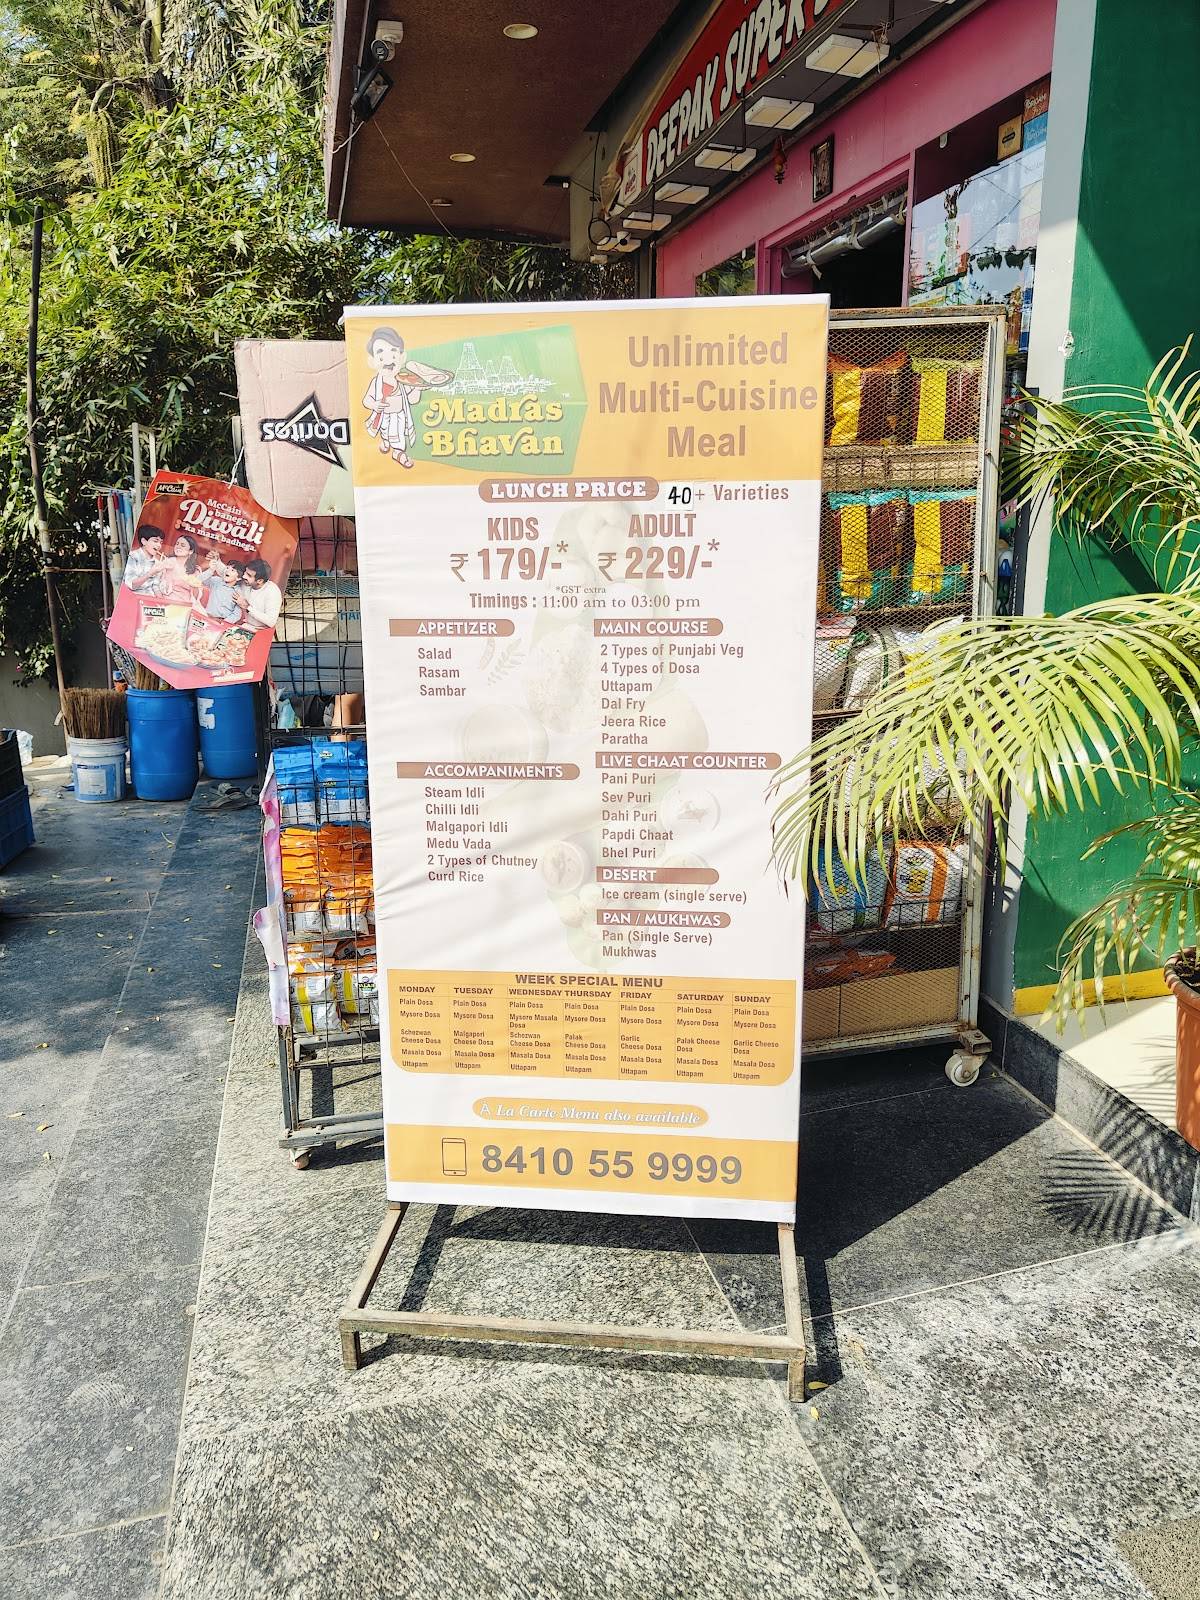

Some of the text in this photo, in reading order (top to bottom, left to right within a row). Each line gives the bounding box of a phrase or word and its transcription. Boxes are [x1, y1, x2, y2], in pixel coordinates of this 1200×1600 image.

[646, 55, 720, 185] DEEPAK
[628, 332, 788, 367] Unlimited
[599, 377, 818, 414] Multi-Cuisine
[422, 392, 563, 427] Madras
[263, 421, 348, 443] Doritos
[423, 428, 564, 456] Bhavan
[668, 425, 746, 458] Meal
[491, 482, 646, 498] LUNCH PRICE
[713, 484, 789, 501] Varieties
[207, 499, 241, 515] McCain
[180, 500, 265, 544] Diwali
[628, 514, 697, 538] ADULT
[487, 517, 539, 541] KIDS
[583, 586, 606, 594] extra
[469, 592, 701, 613] Timings 11:00 am to 03:00 pm
[417, 622, 497, 635] APPETIZER
[600, 621, 708, 634] MAIN COURSE
[418, 648, 452, 659] Salad
[600, 643, 744, 658] 2 Types of Punjabi Veg
[419, 667, 460, 678] Rasam
[600, 662, 700, 676] 4 Types of Dosa
[420, 684, 466, 697] Sambar
[601, 680, 652, 695] Uttapam
[601, 698, 646, 712] Dal Fry
[601, 716, 666, 727] Jeera Rice
[602, 733, 648, 745] Paratha
[601, 755, 767, 768] LIVE CHAAT COUNTER
[424, 765, 563, 778] ACCOMPANIMENTS
[601, 773, 655, 785] Pani Puri
[425, 787, 485, 798] Steam Idli
[602, 792, 651, 803] Sev Puri
[425, 803, 479, 815] Chilli Idli
[602, 810, 657, 822] Dahi Puri
[426, 820, 508, 835] Malgapori Idli
[602, 829, 673, 842] Papdi Chaat
[427, 838, 491, 849] Medu Vada
[602, 847, 656, 859] Bhel Puri
[427, 855, 537, 869] 2 Types of Chutney
[428, 871, 484, 882] Curd Rice
[603, 869, 657, 881] DESERT
[602, 888, 747, 905] Ice cream (single serve)
[603, 913, 631, 924] PAN
[644, 914, 720, 926] MUKHWAS
[602, 930, 712, 946] Pan (Single Serve)
[602, 946, 657, 958] Mukhwas
[515, 974, 663, 987] WEEK SPECIAL MENU
[565, 990, 612, 998] THURSDAY
[677, 993, 724, 1001] SATURDAY
[734, 995, 771, 1003] SUNDAY
[677, 1006, 693, 1014] Plain
[734, 1008, 750, 1016] Plain
[621, 1017, 644, 1025] Mysore
[696, 1038, 720, 1046] Cheese
[734, 1039, 779, 1048] Garlic Cheese
[496, 1104, 514, 1116] La
[519, 1105, 555, 1118] Carte
[561, 1106, 599, 1120] Menu
[604, 1108, 630, 1122] also
[636, 1110, 700, 1125] available
[482, 1144, 742, 1185] 8410 55 9999
